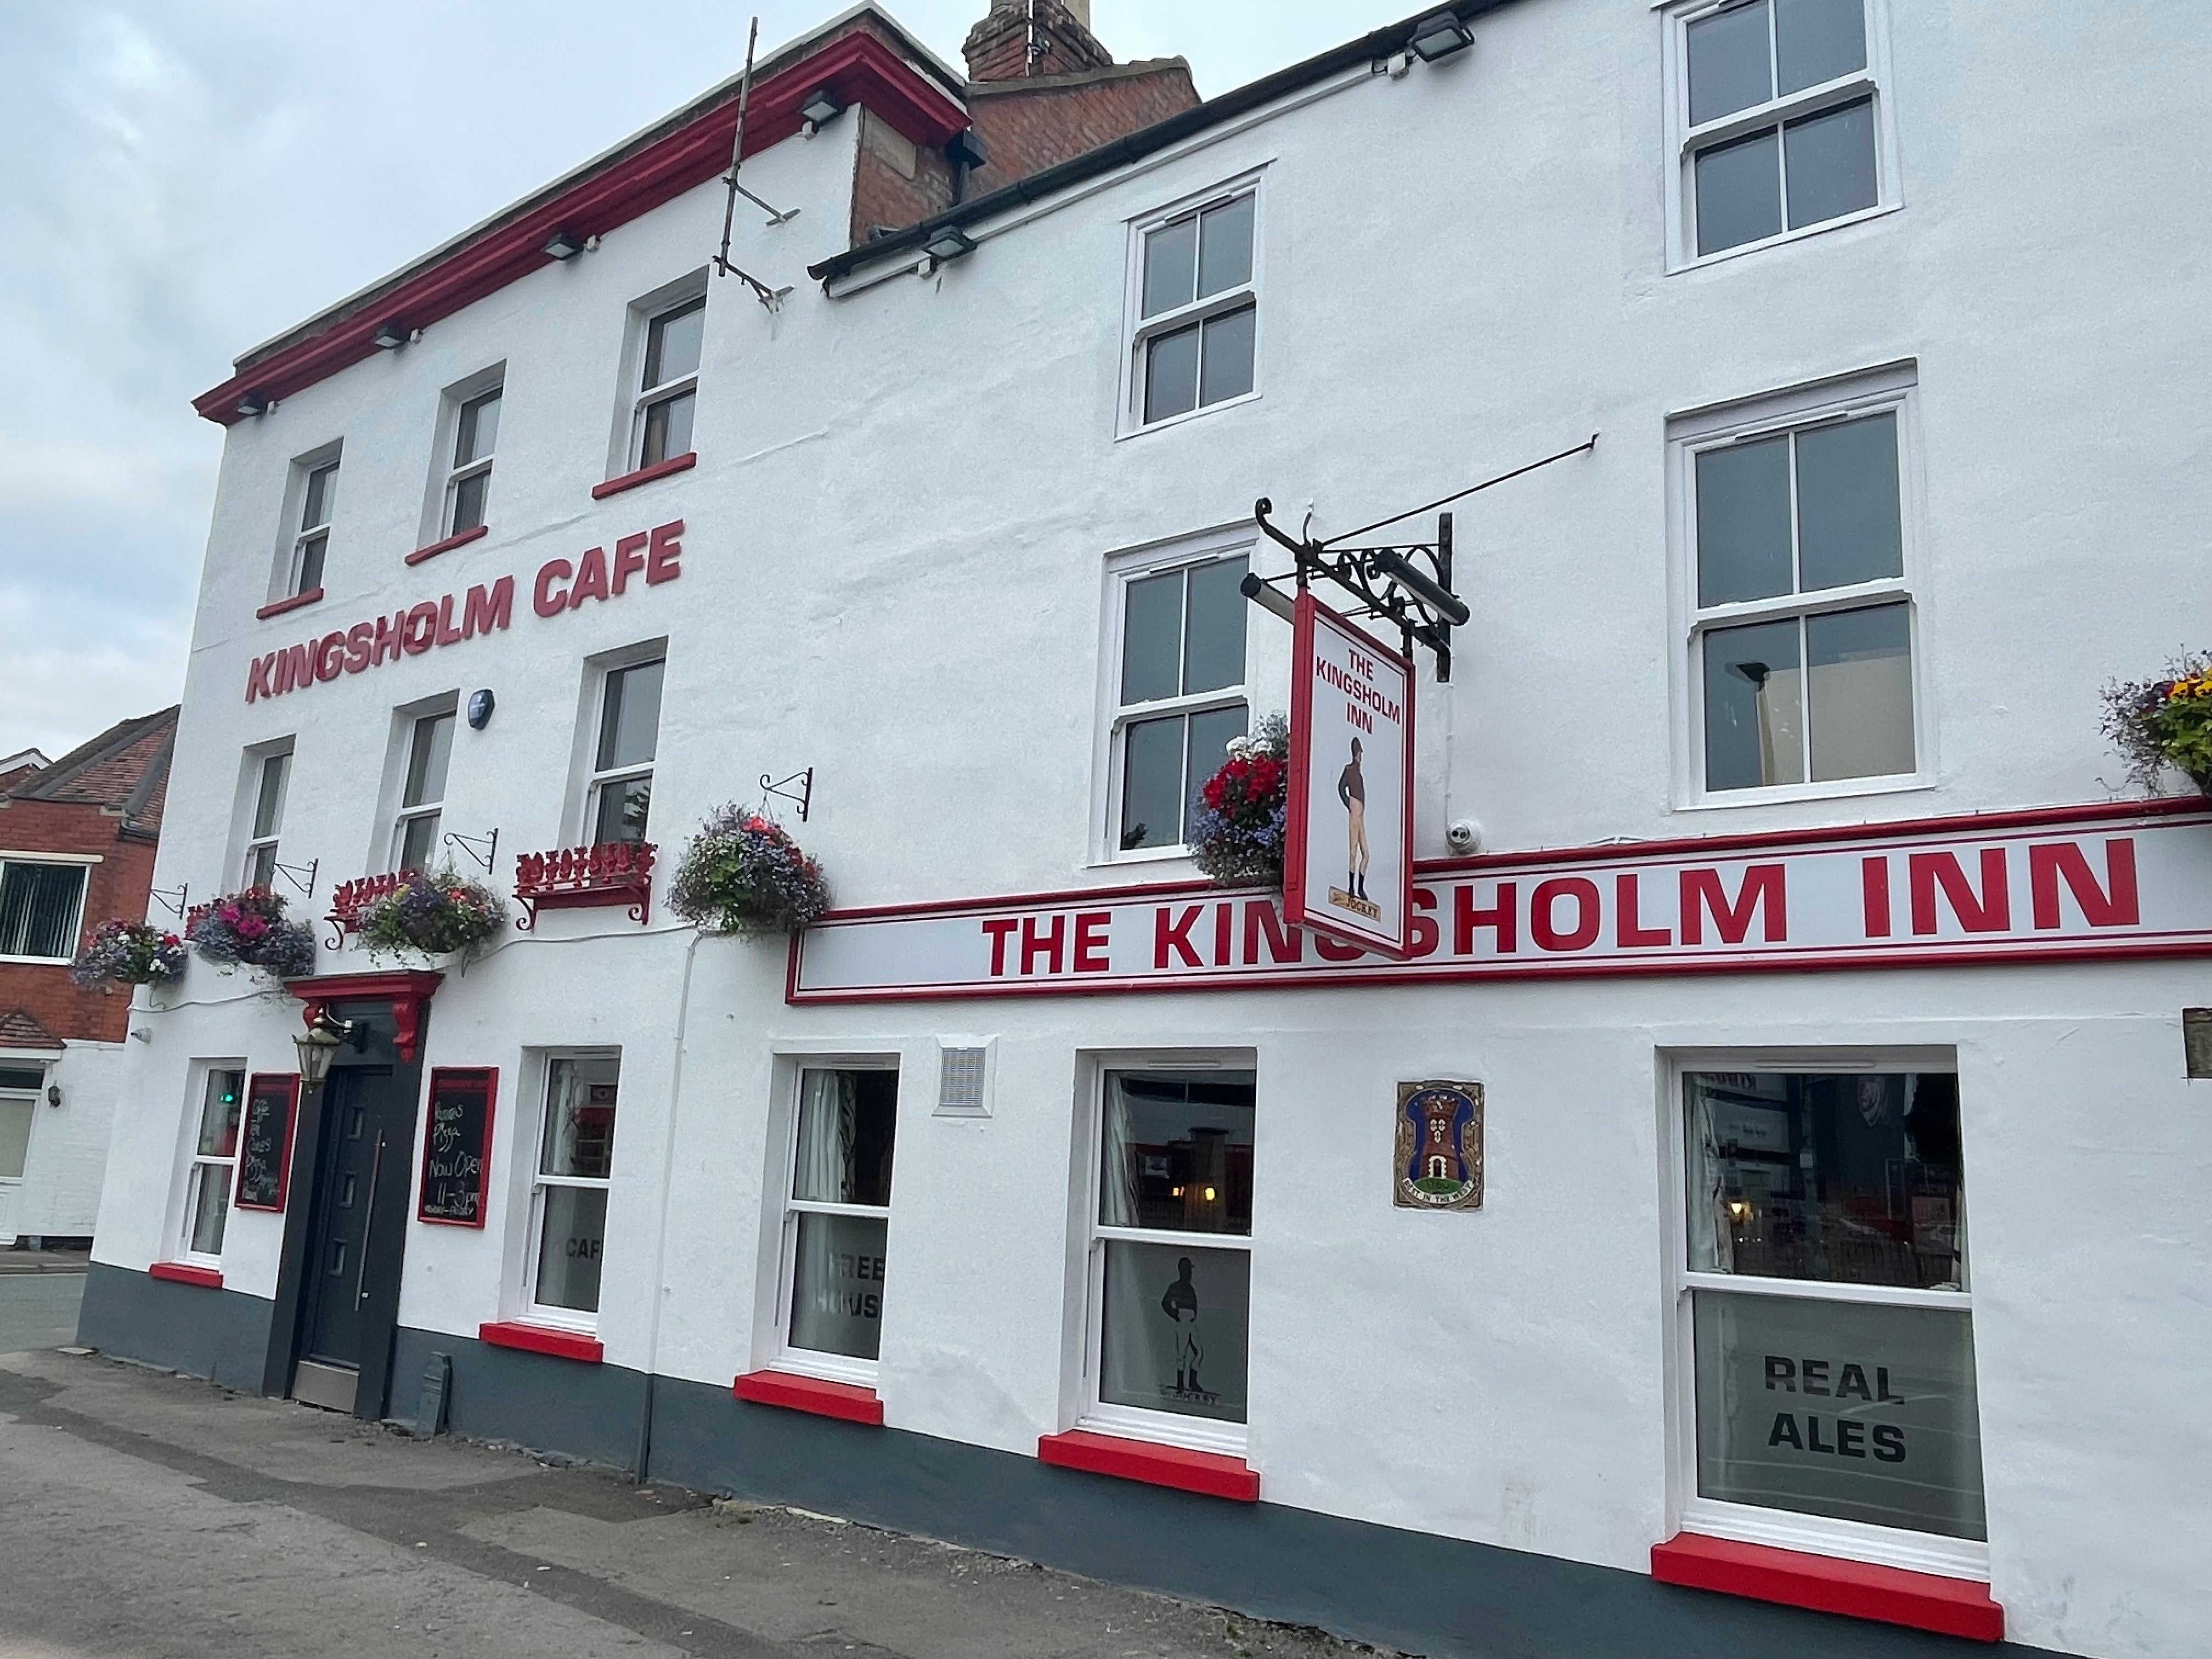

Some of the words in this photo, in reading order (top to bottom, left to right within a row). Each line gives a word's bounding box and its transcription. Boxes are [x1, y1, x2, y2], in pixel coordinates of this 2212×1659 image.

[245, 575, 515, 704] KINGSHOLM
[533, 519, 686, 618] CAFE
[1348, 647, 1374, 682] THE
[1317, 656, 1400, 725] KINGSHOLM
[1346, 702, 1373, 735] INN
[981, 911, 1111, 977] THE
[1154, 864, 1786, 969] KINSHOLM
[1863, 838, 2140, 938] INN
[1346, 898, 1378, 918] JOCKEY
[1764, 1355, 1905, 1404] REAL
[1768, 1412, 1906, 1463] ALES
